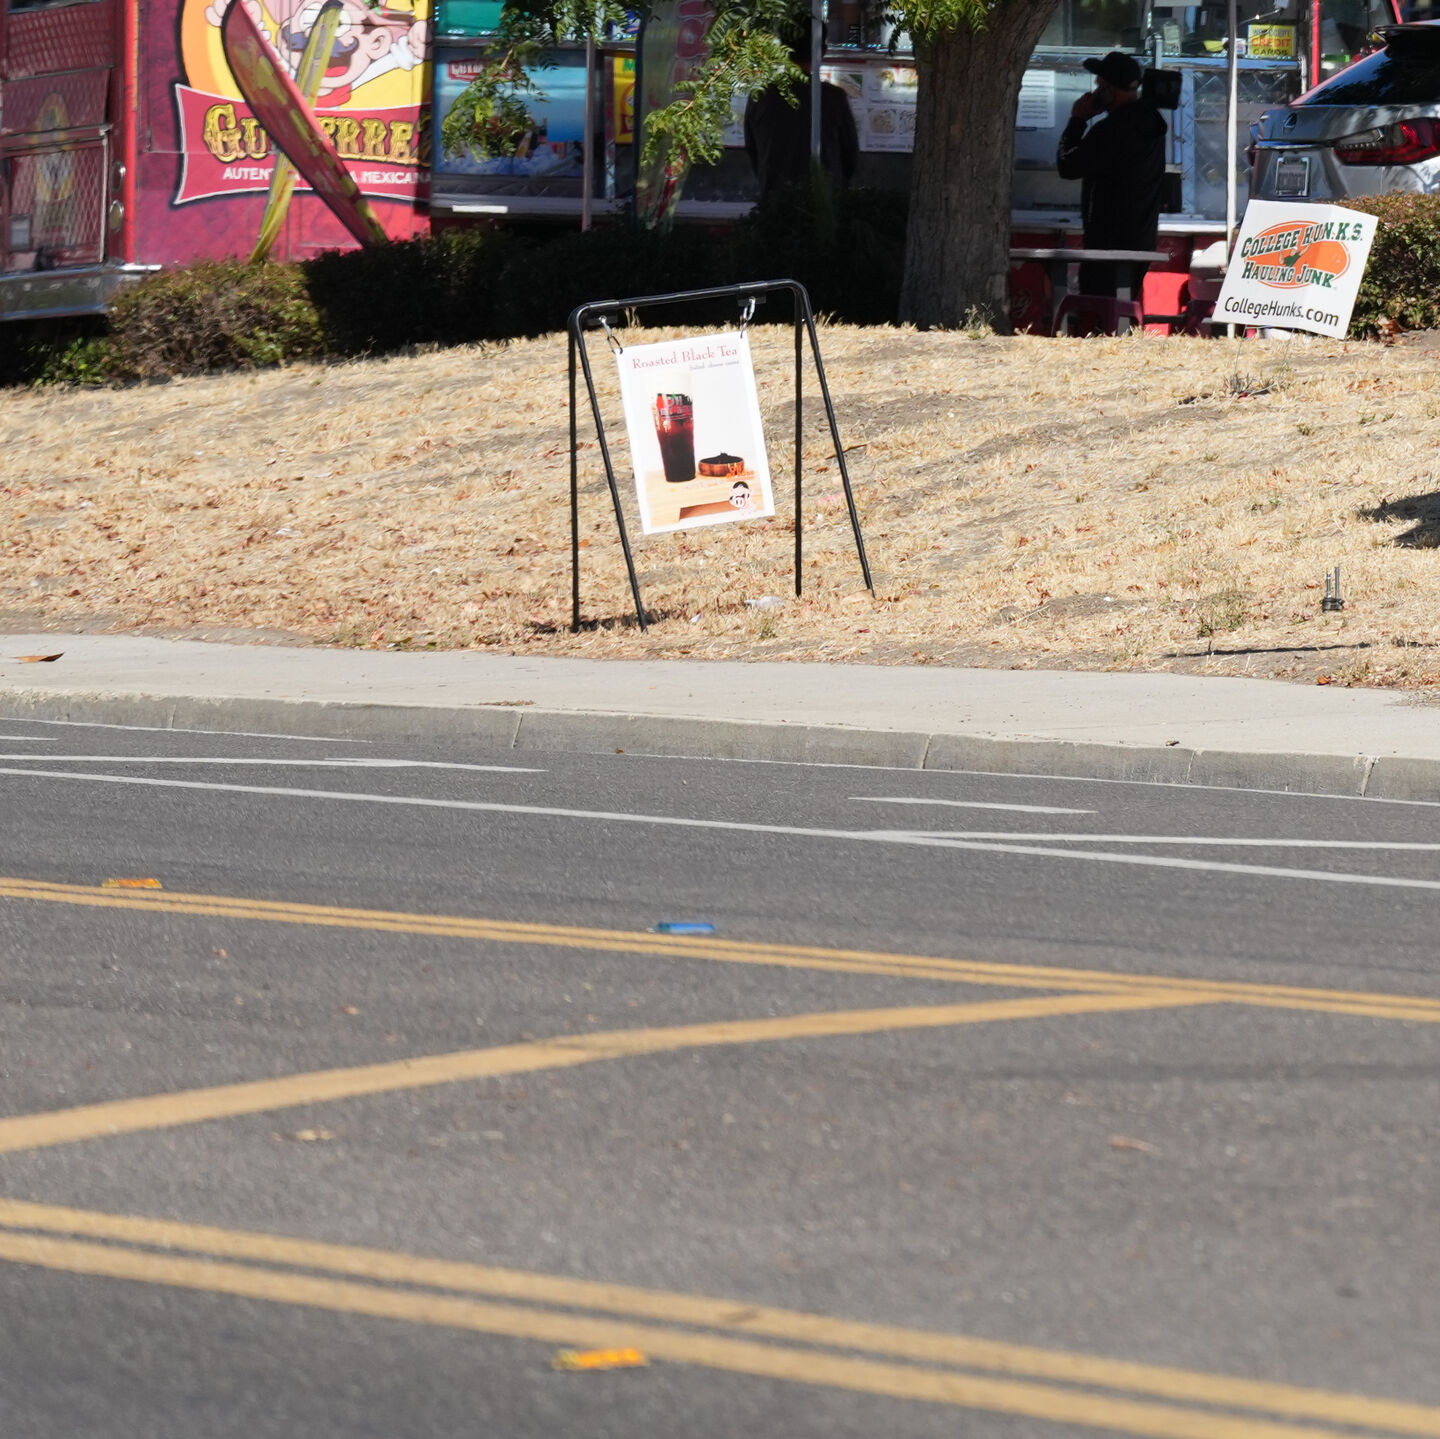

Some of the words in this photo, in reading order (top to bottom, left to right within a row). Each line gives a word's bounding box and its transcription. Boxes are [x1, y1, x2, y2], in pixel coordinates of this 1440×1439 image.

[1251, 38, 1292, 48] CREDIT
[1241, 229, 1302, 259] COLLEGE
[1241, 261, 1296, 283] HAULING
[1296, 265, 1336, 289] JUNK
[1224, 296, 1340, 327] CollegeHunks.com
[631, 351, 678, 369] Roasted
[681, 346, 716, 362] Black
[718, 344, 738, 358] Tea
